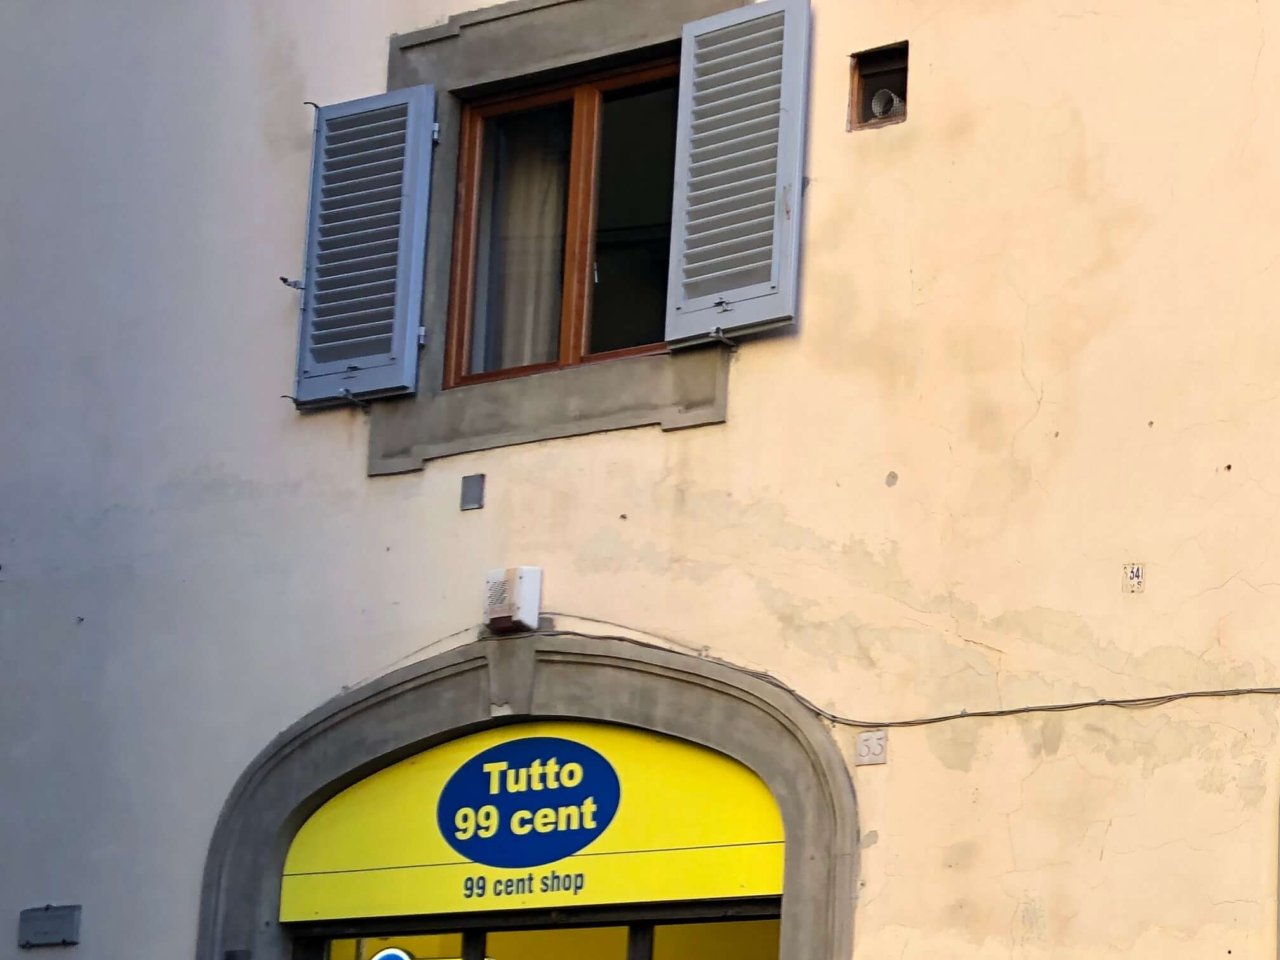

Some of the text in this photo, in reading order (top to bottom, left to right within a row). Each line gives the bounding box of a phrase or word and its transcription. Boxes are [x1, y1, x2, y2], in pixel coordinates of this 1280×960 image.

[483, 757, 584, 795] Tutto
[454, 797, 598, 841] 99 cent
[463, 870, 585, 899] 99 cent shop
